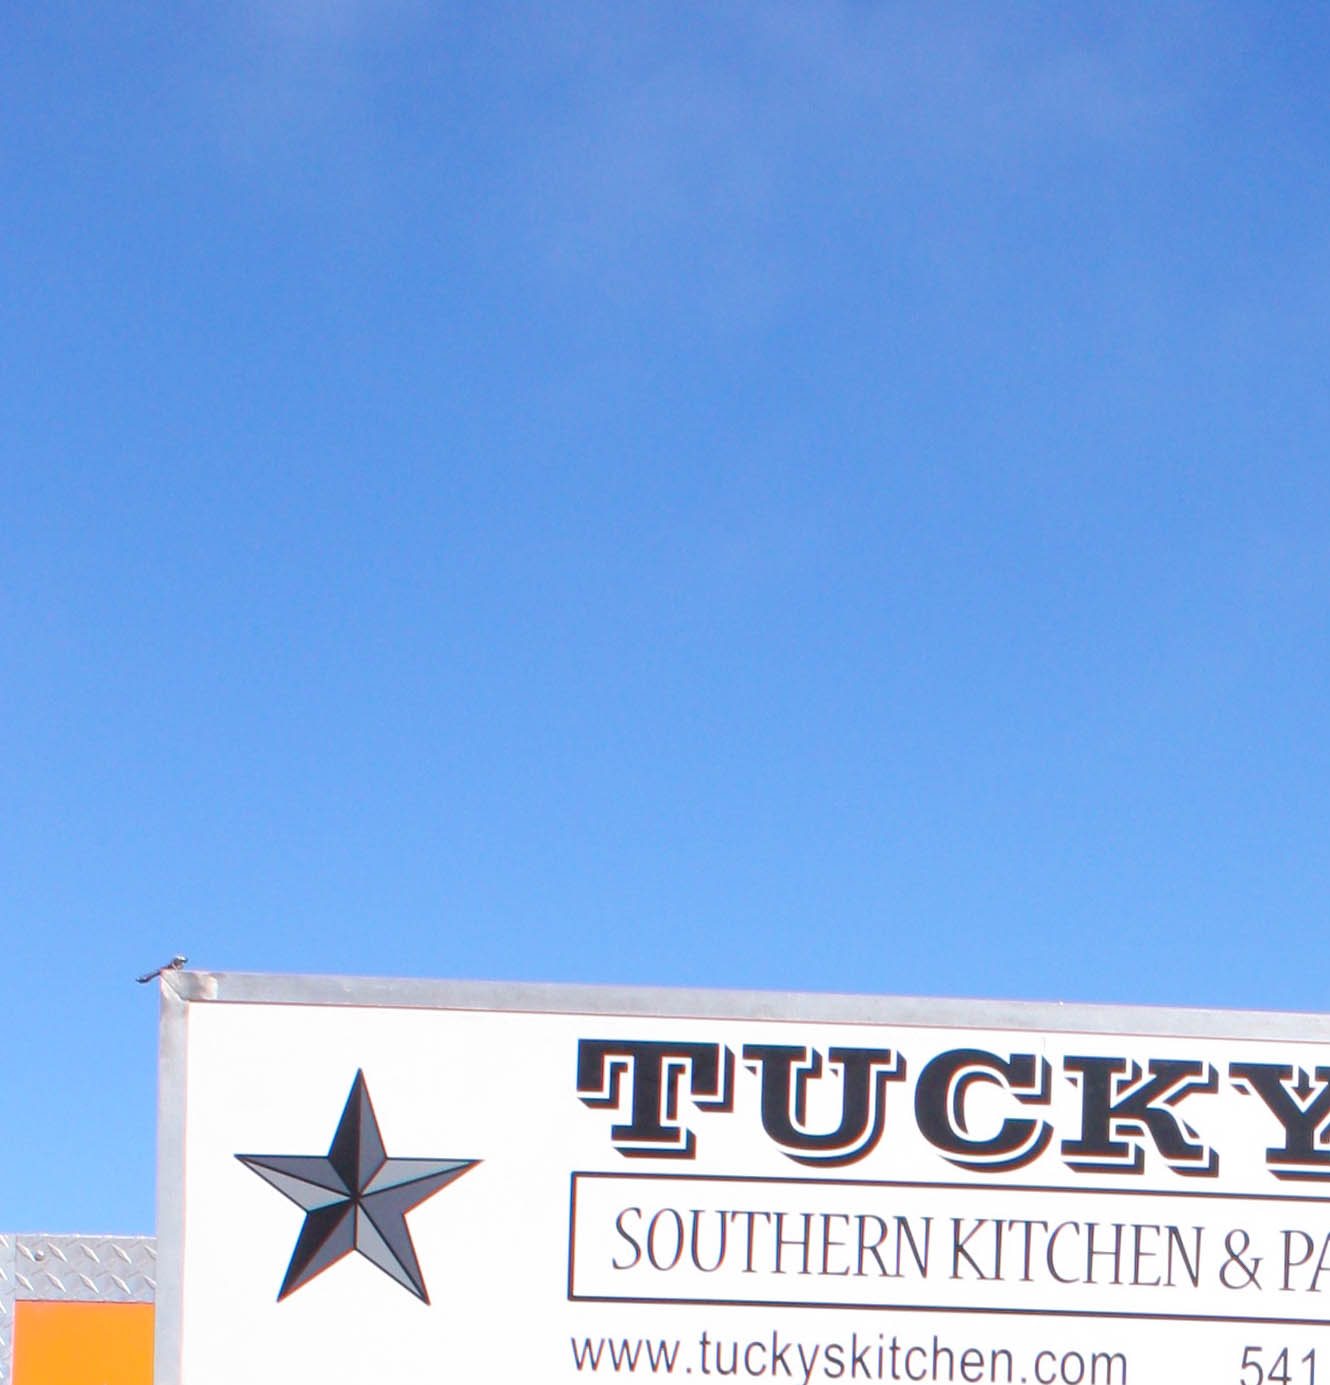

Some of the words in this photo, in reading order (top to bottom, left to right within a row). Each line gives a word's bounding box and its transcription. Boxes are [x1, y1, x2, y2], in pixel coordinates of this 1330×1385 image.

[612, 1208, 933, 1279] SOUTHERN
[951, 1218, 1205, 1287] KITCHEN
[1219, 1230, 1263, 1290] &
